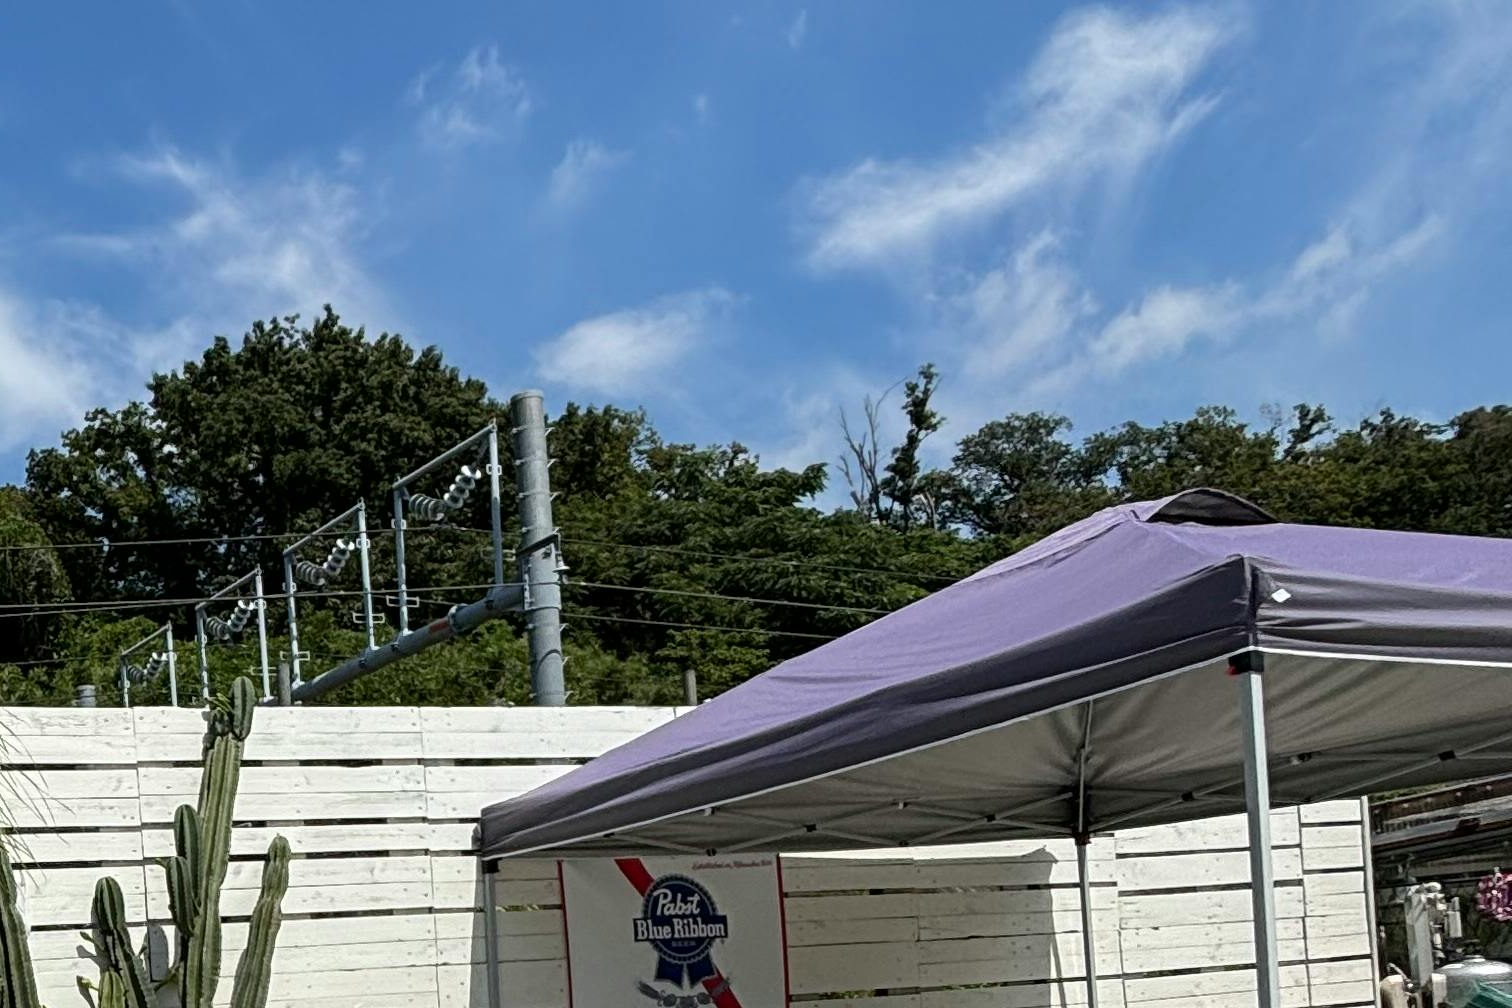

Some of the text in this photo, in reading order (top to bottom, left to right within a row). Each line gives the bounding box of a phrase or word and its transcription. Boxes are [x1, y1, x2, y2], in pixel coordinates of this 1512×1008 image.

[652, 888, 701, 916] Pabst
[635, 917, 726, 940] Blue Ribbon
